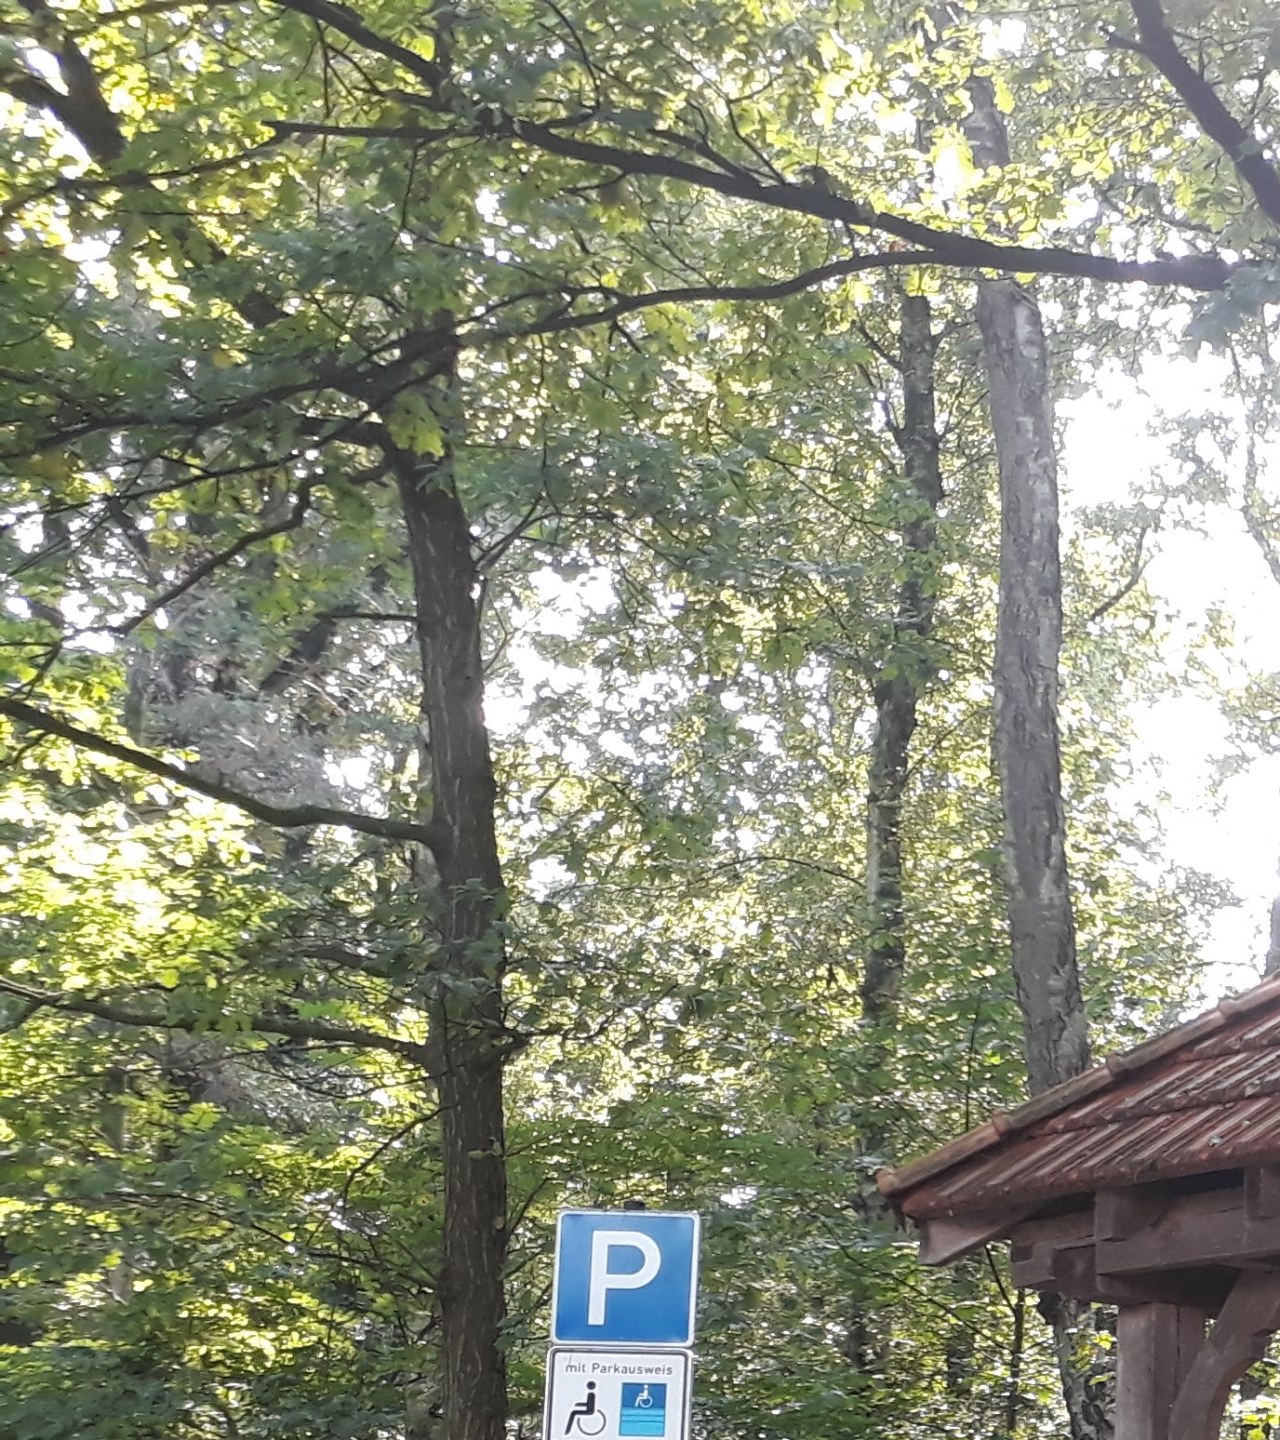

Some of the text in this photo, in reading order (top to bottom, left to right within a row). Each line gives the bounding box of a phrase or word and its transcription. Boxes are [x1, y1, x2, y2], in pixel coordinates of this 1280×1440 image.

[587, 1230, 662, 1327] P
[565, 1362, 673, 1375] mit Parkausweis
